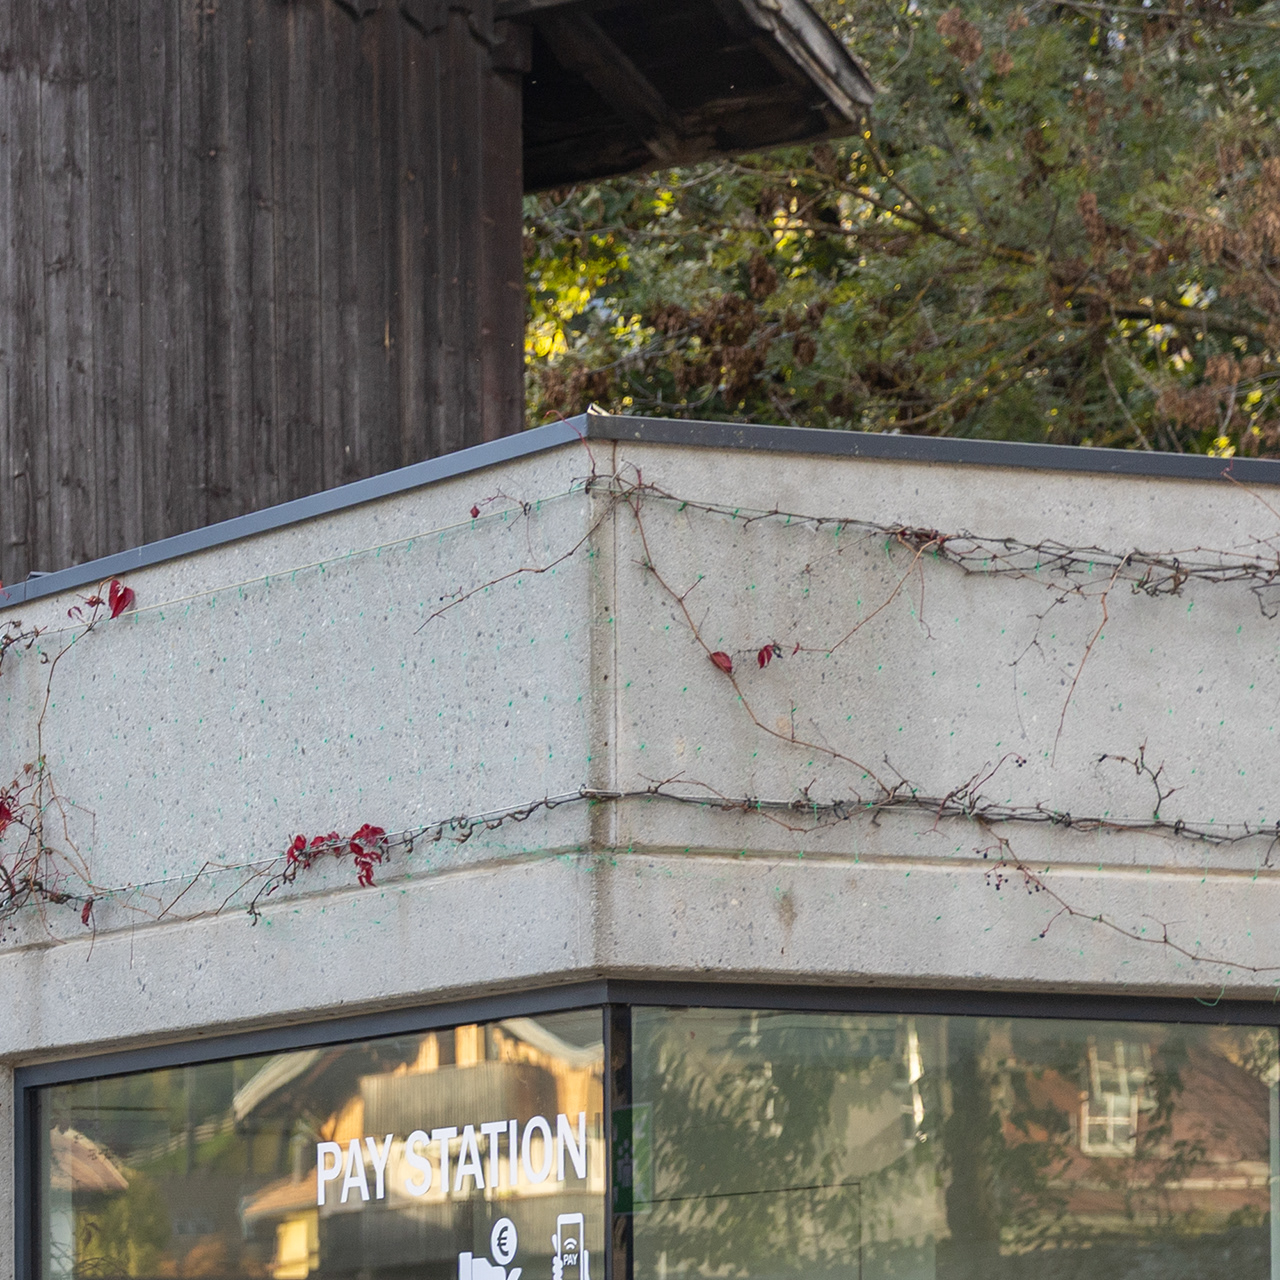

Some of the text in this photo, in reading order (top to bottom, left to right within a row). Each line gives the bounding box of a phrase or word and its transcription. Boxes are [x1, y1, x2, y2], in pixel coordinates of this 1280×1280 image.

[317, 1112, 587, 1206] PAY STATION
[563, 1253, 579, 1266] PAY
